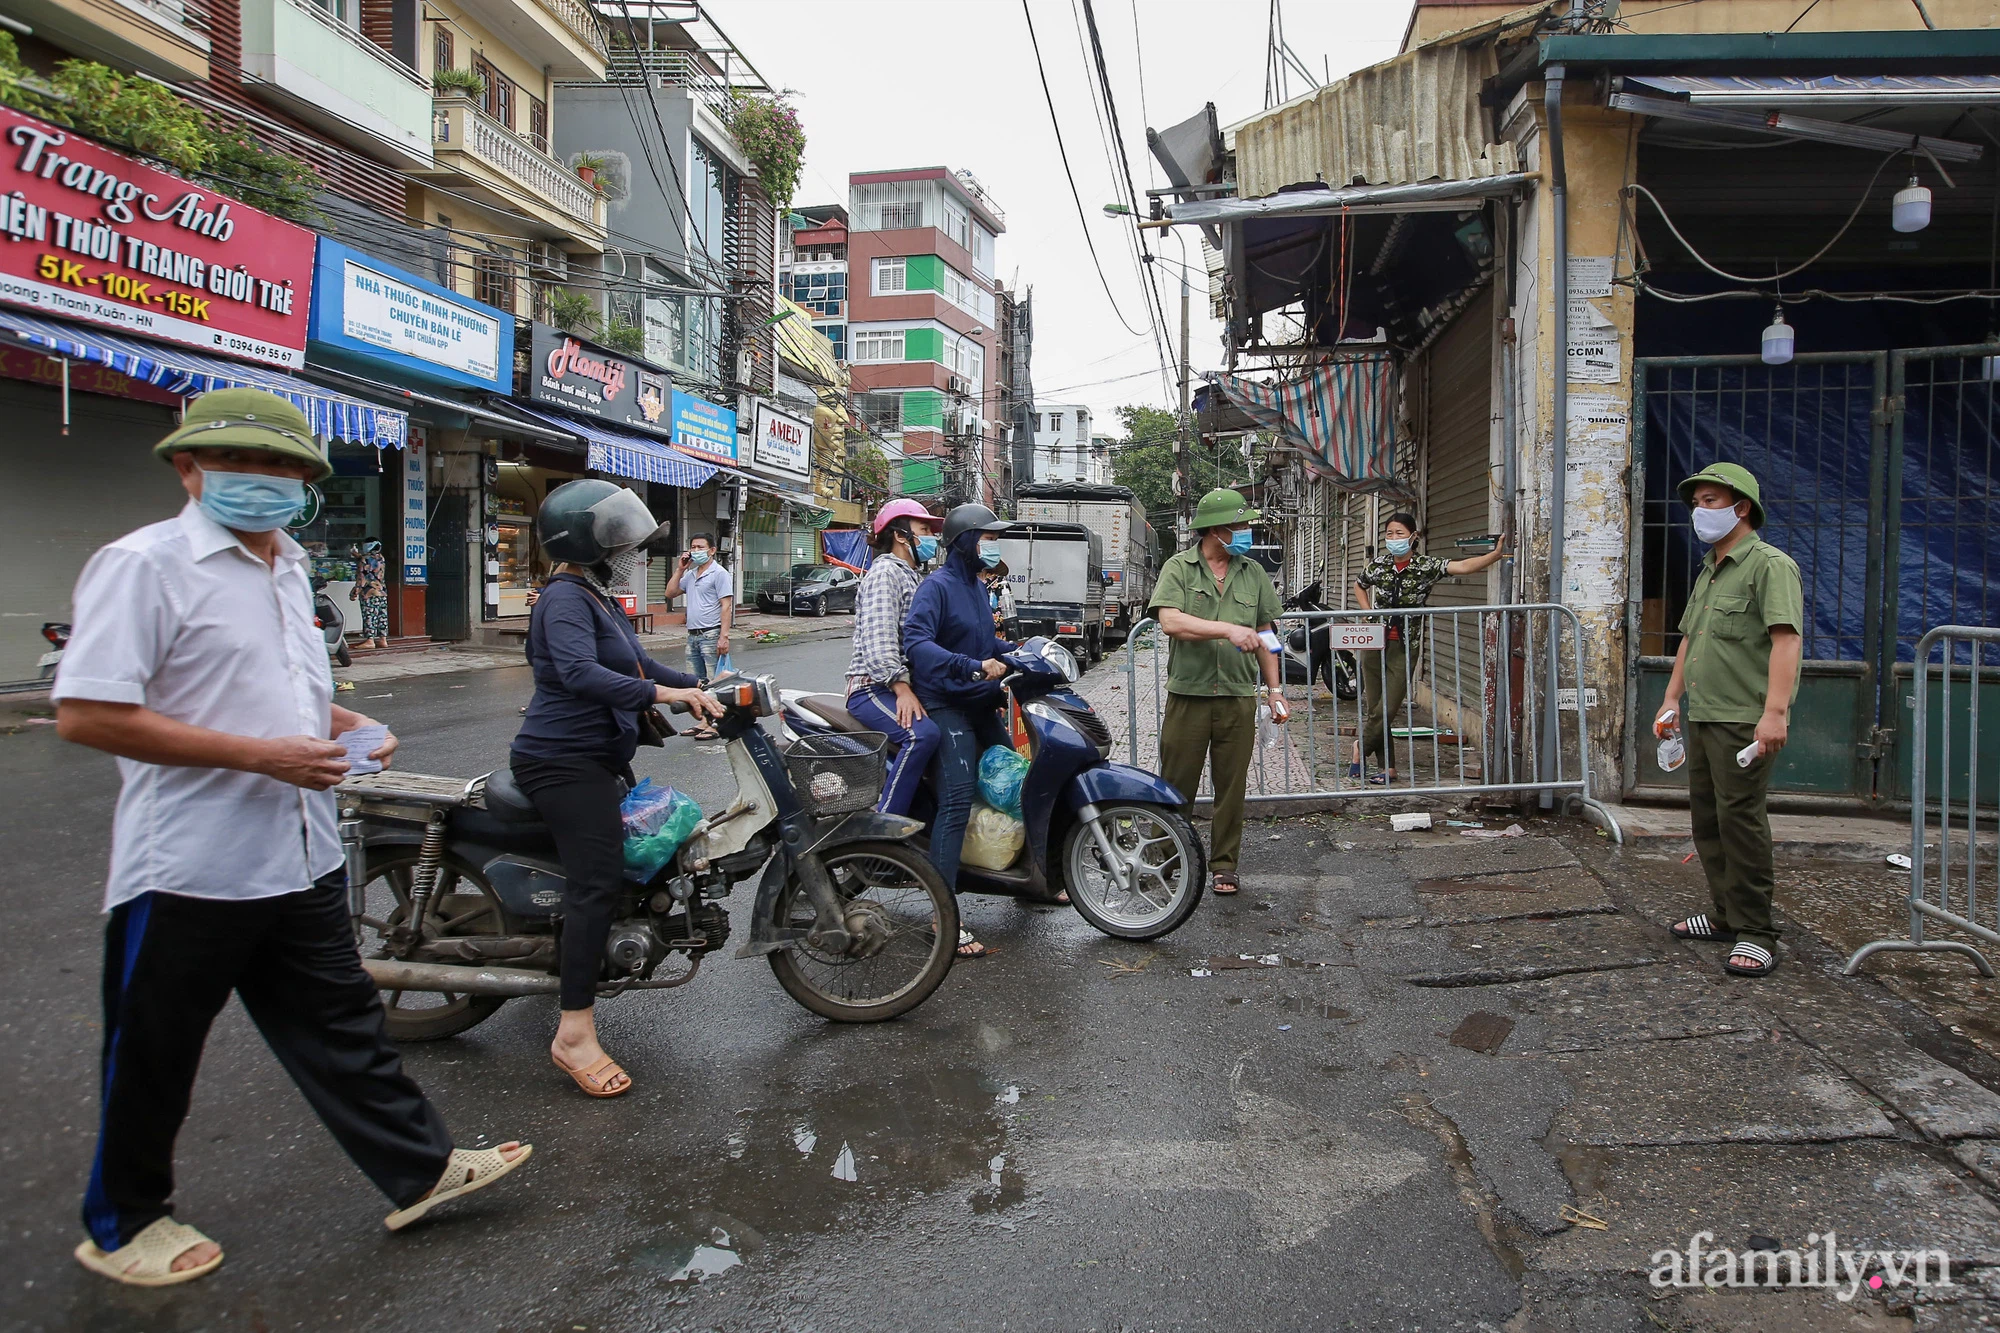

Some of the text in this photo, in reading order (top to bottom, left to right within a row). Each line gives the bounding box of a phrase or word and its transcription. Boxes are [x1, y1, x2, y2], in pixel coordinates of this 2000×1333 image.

[12, 125, 234, 242] Trang Anh
[54, 217, 120, 263] THỜI
[126, 235, 205, 289] TRANG
[210, 264, 254, 304] GIỚI
[259, 280, 294, 316] TRẺ
[52, 292, 91, 313] Thanh
[94, 303, 126, 321] Xuân
[136, 313, 153, 328] HN
[355, 274, 489, 336] NHÀ THUỐC MINH PHƯƠNG
[390, 307, 462, 343] CHUYÊN BÁN LẺ
[230, 338, 292, 362] 0394 69 55 67
[404, 328, 417, 341] ĐẠT
[437, 339, 449, 350] GPP
[1567, 347, 1604, 356] CCMN
[547, 337, 626, 401] Momiji
[542, 375, 560, 391] Bánh
[769, 418, 803, 447] AMELY
[409, 498, 423, 510] MINH
[406, 544, 425, 559] GPP
[1341, 635, 1374, 645] STOP
